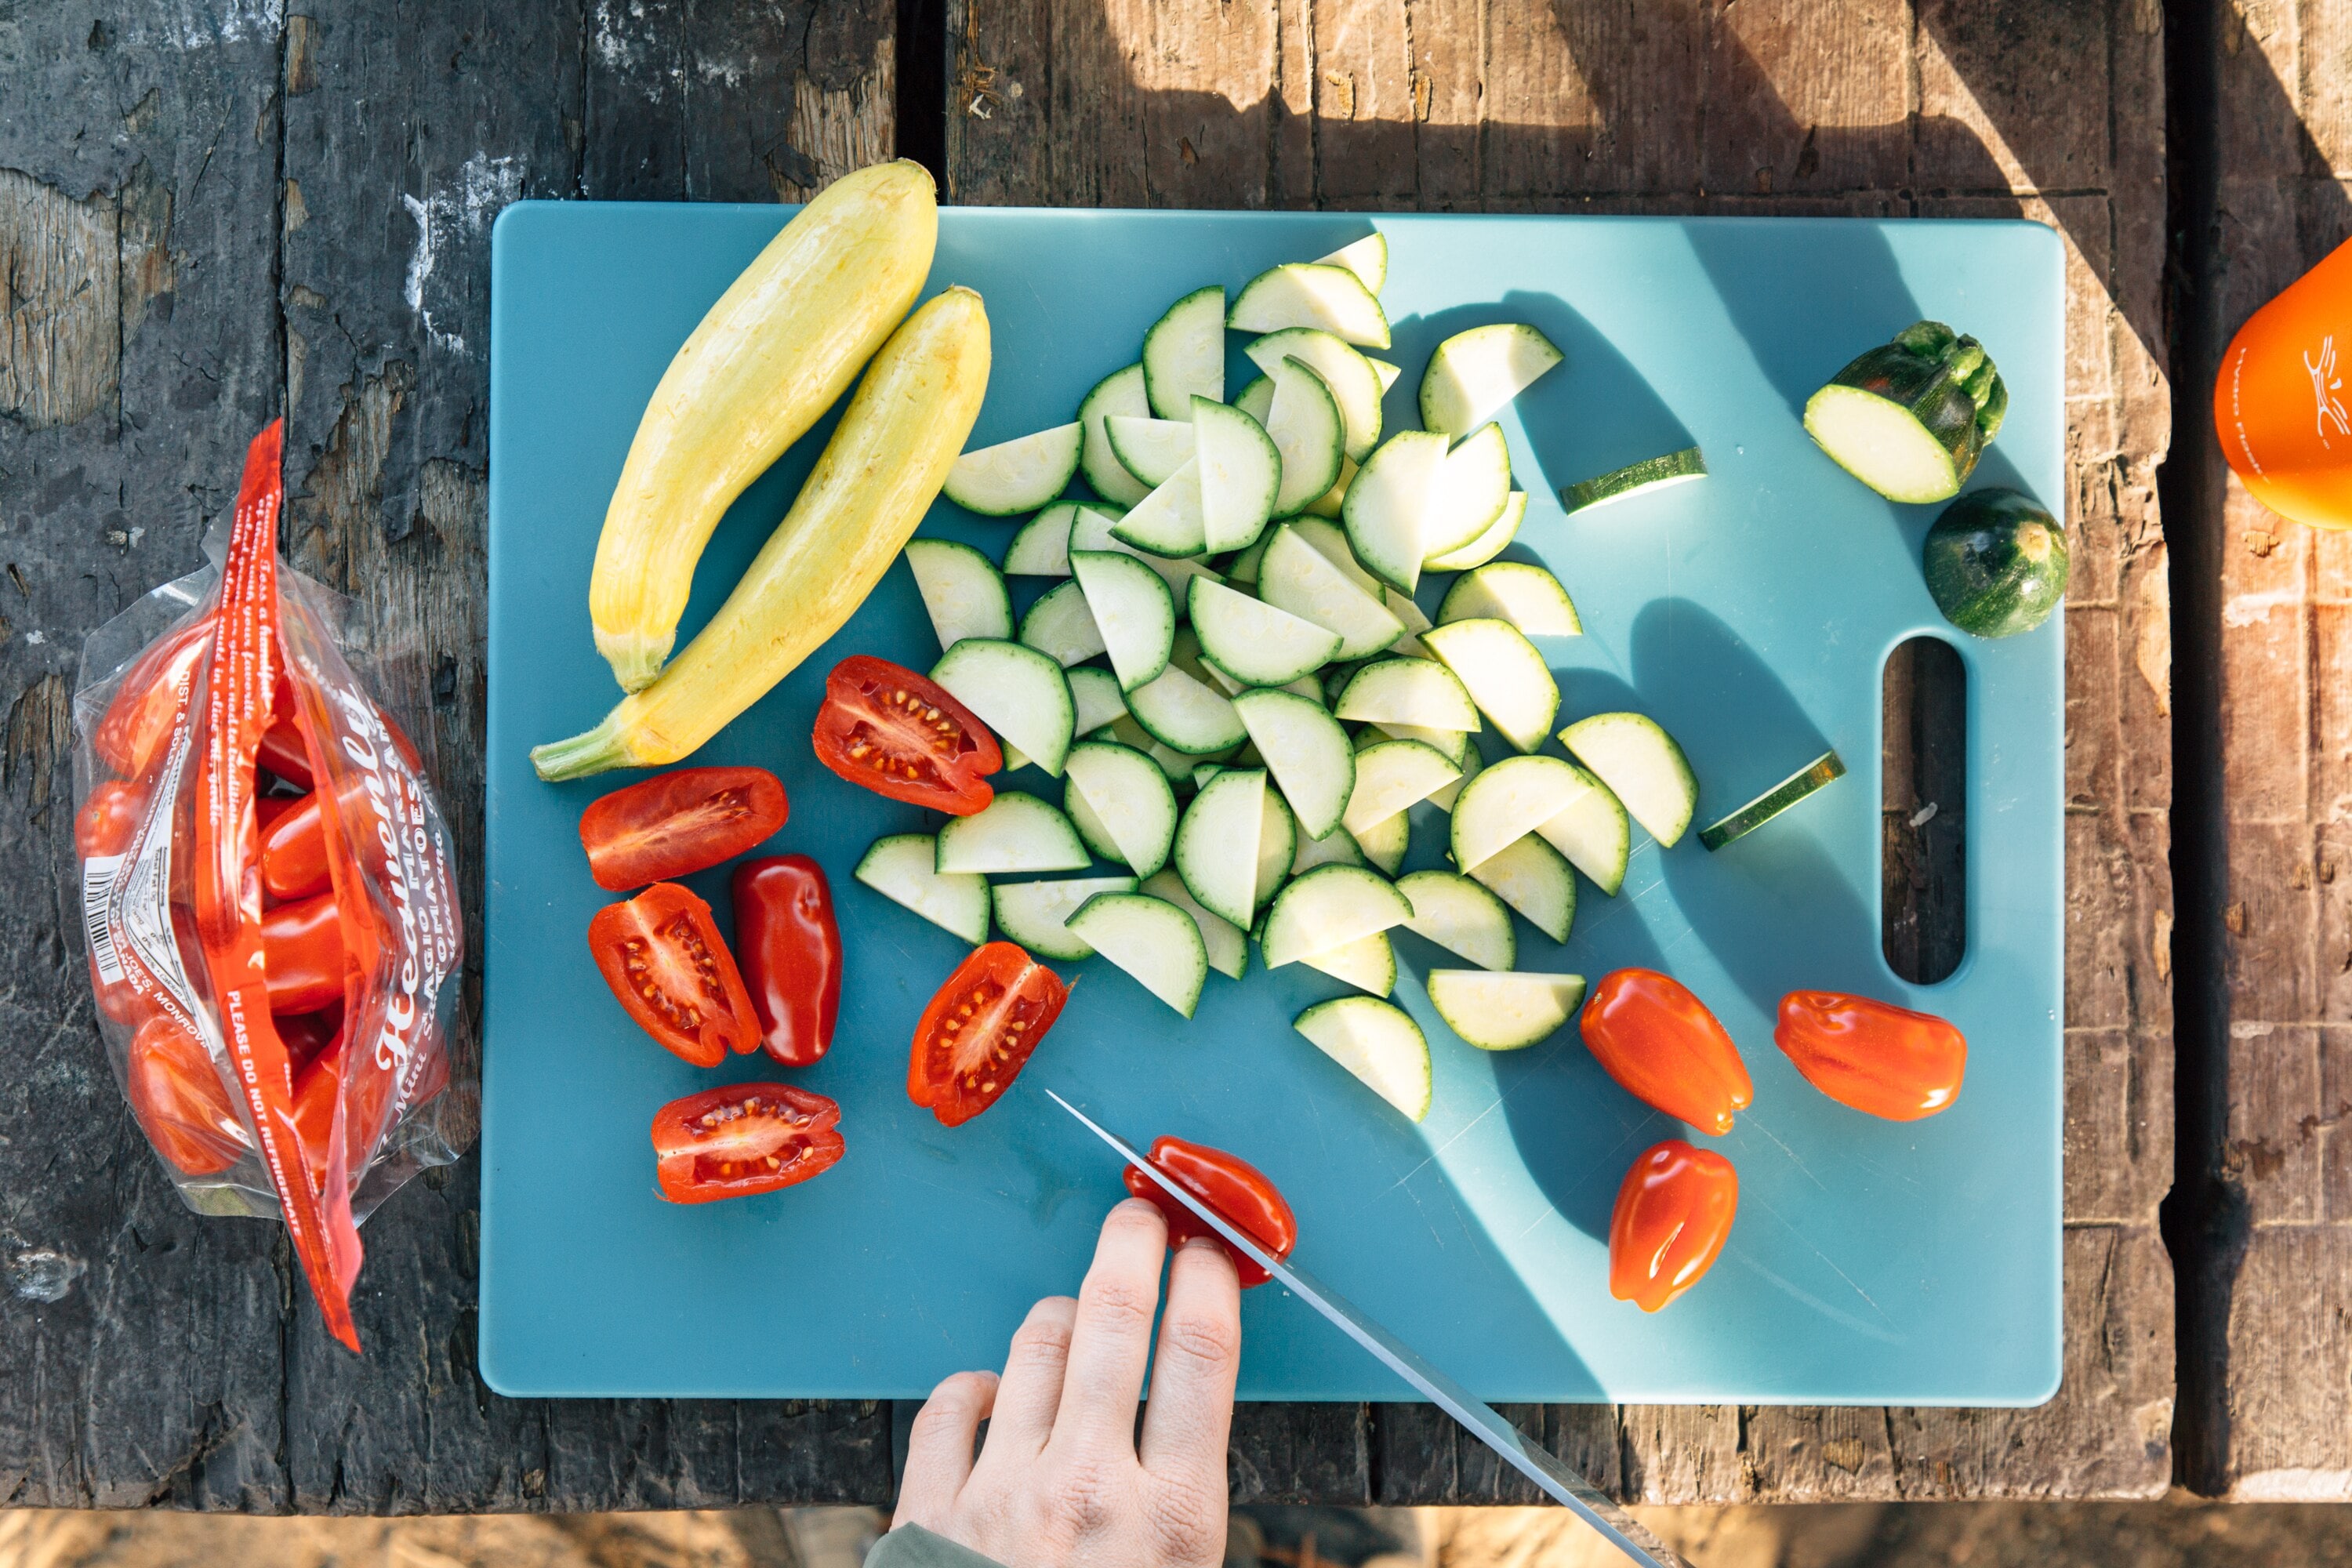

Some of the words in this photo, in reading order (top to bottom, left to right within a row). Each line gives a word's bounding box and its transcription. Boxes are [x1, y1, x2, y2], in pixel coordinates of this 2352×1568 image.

[232, 508, 243, 546] with
[256, 498, 265, 518] of
[241, 504, 253, 554] salad
[250, 520, 263, 561] them
[228, 550, 235, 564] a
[220, 568, 234, 609] slow
[245, 564, 255, 602] with
[260, 558, 271, 602] Toss
[242, 605, 252, 648] your
[260, 606, 267, 621] a
[213, 667, 224, 684] in
[228, 640, 238, 674] give
[176, 670, 191, 707] DIST.
[228, 677, 235, 690] a
[241, 651, 256, 720] favorite
[176, 712, 186, 724] &
[212, 690, 223, 732] olive
[227, 691, 239, 726] nod
[165, 726, 183, 766] SOLD
[227, 727, 238, 745] to
[207, 772, 222, 828] garlic
[227, 747, 241, 824] tradition
[339, 683, 419, 1070] Heavenly
[407, 779, 448, 990] TOMATOES
[113, 931, 144, 996] CANADA
[125, 952, 153, 993] JOE'S,
[394, 1052, 426, 1123] Mini
[227, 990, 251, 1055] PLEASE
[241, 1058, 257, 1084] DO
[249, 1088, 268, 1123] NOT
[260, 1126, 302, 1236] REFRIGERATE
